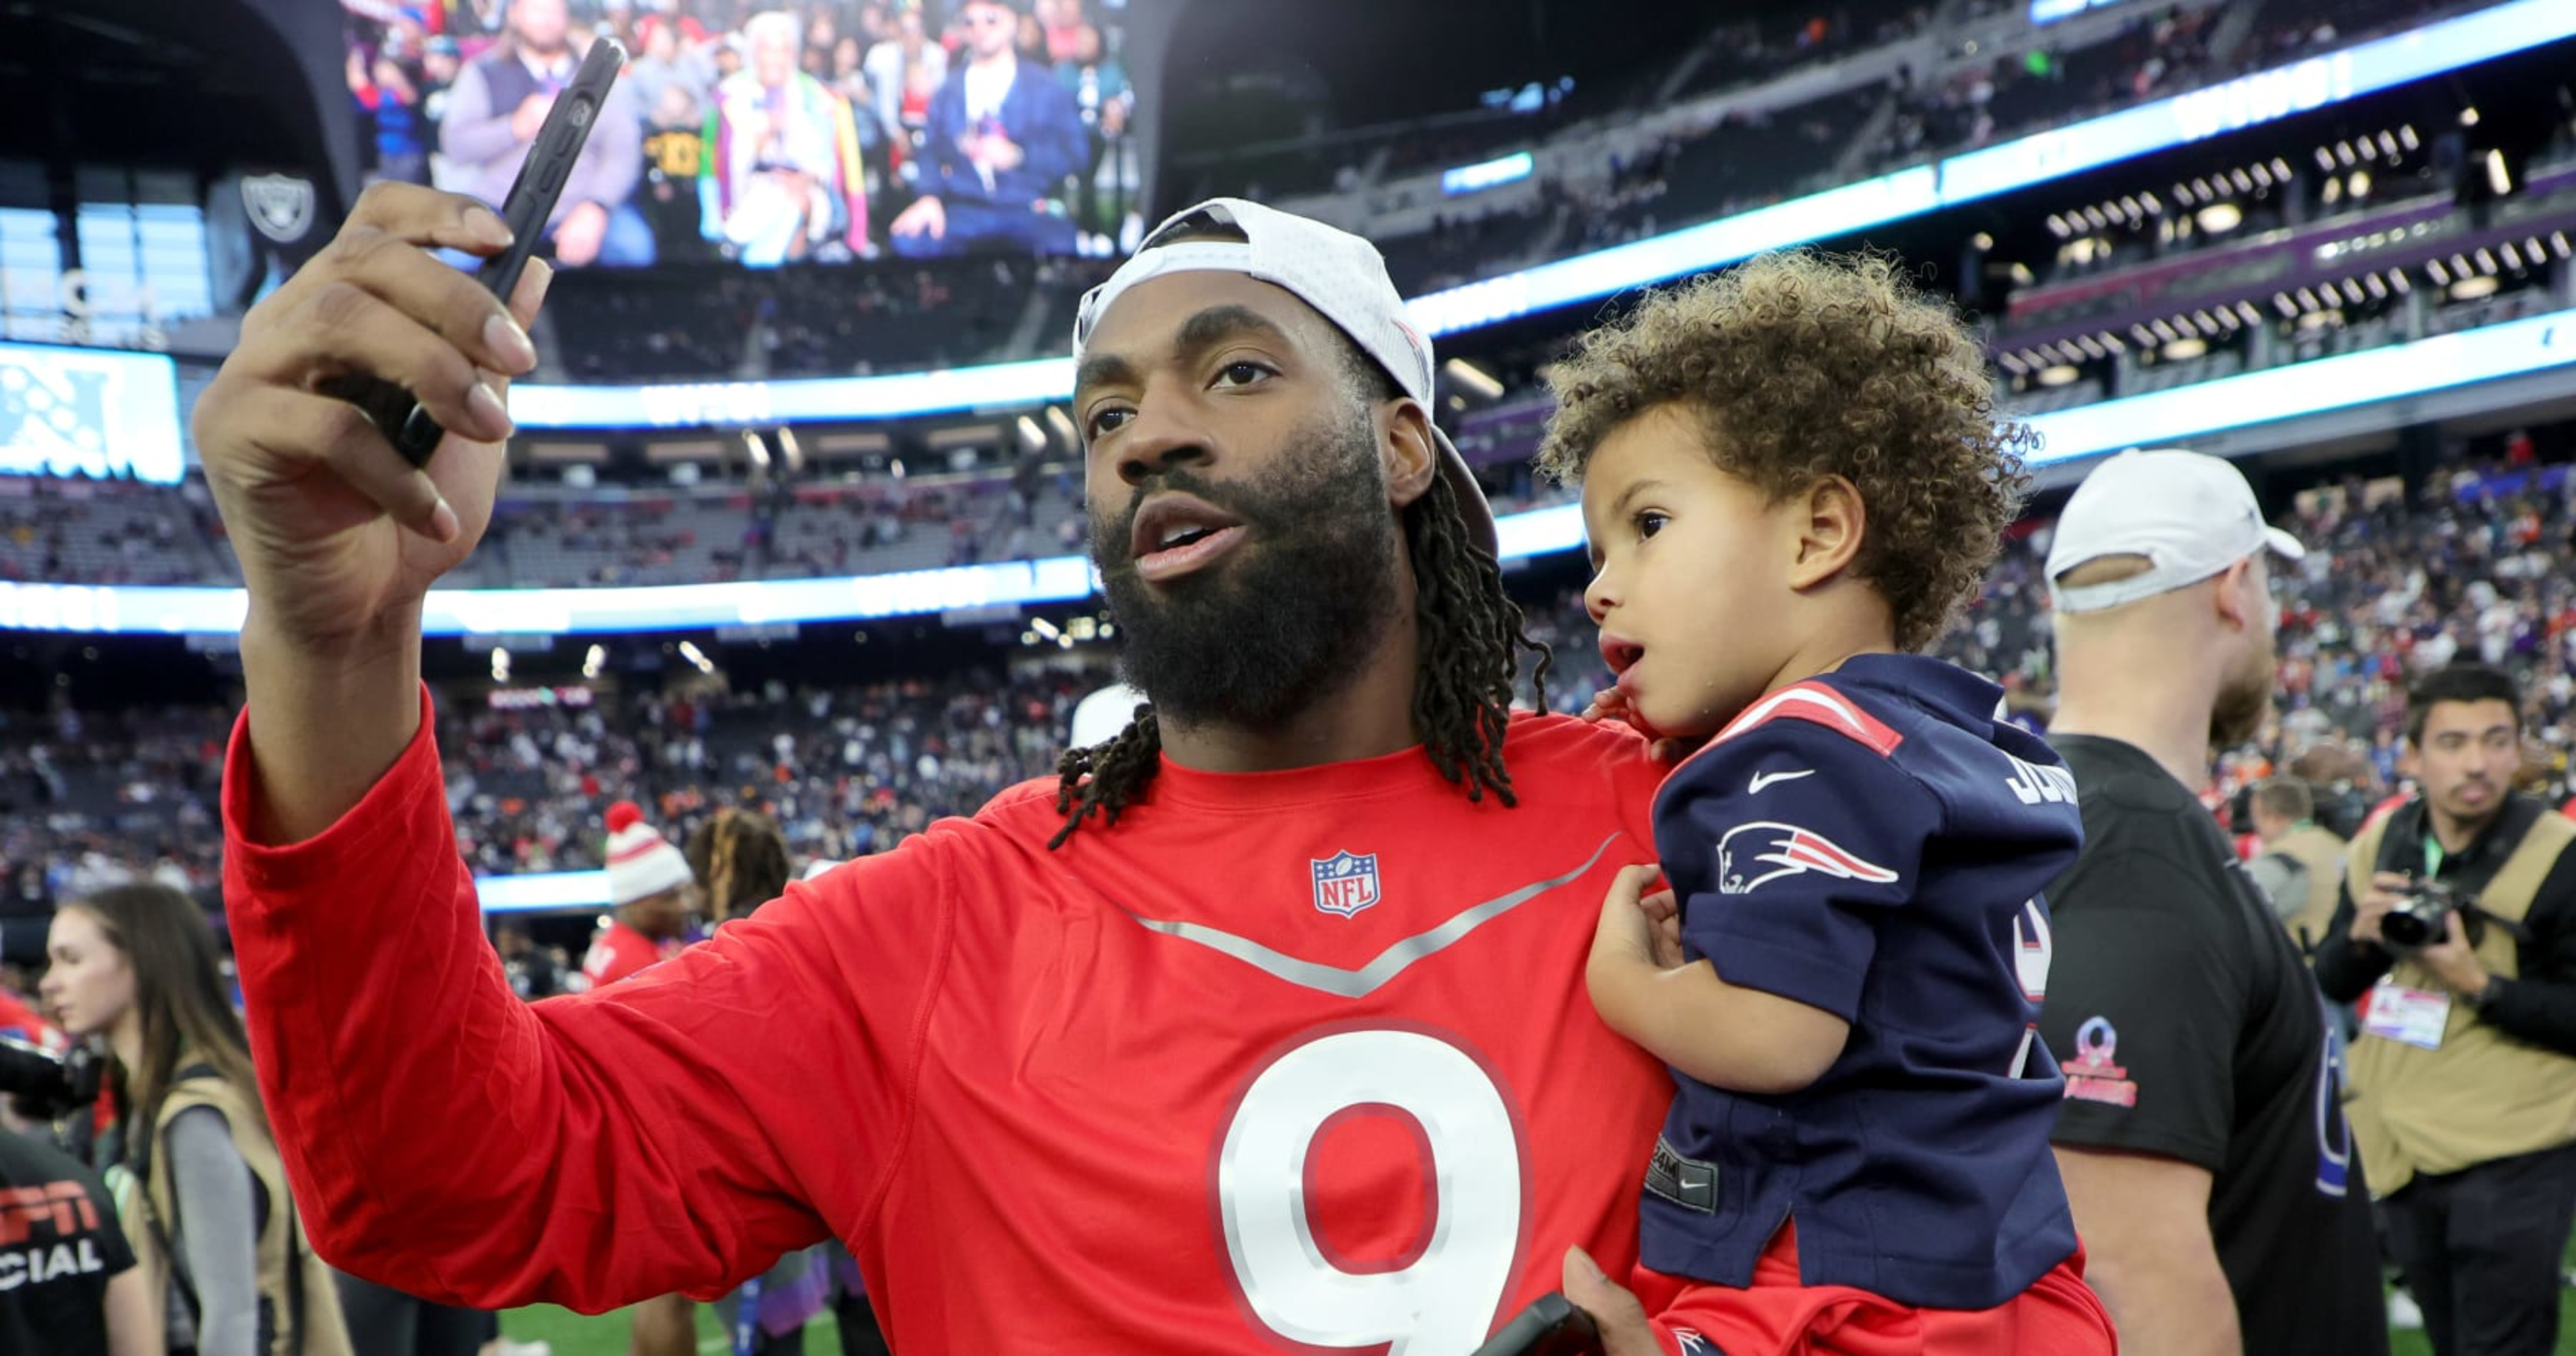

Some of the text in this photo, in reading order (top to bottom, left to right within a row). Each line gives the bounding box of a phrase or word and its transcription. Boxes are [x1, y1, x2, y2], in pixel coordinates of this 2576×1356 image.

[1321, 877, 1372, 907] NFL
[1215, 1025, 1527, 1356] 9
[0, 1239, 104, 1291] CIAL
